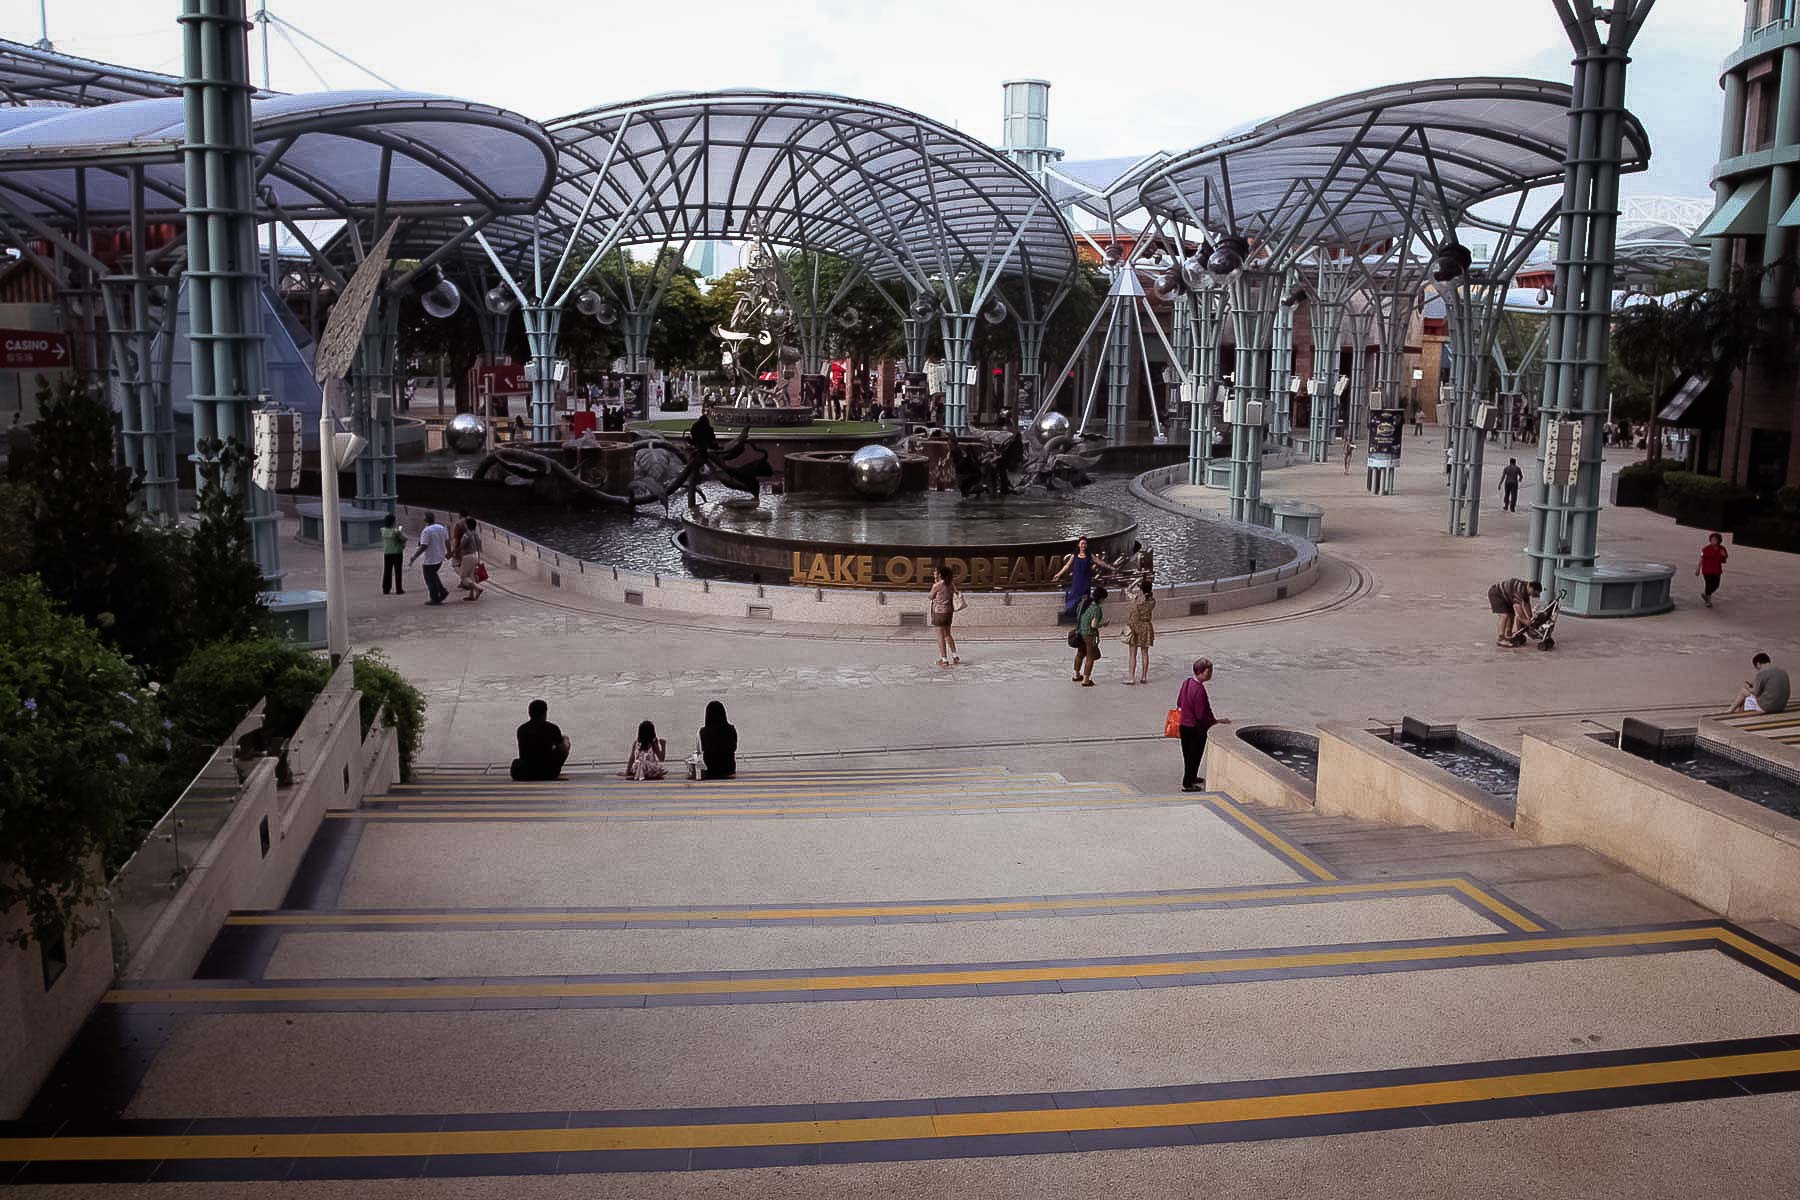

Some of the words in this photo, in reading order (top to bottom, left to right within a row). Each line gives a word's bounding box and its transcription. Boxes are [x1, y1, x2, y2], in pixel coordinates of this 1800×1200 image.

[5, 340, 49, 351] CASINO
[793, 551, 873, 585] LAKE
[885, 555, 933, 585] OF
[944, 555, 1074, 585] DREAM
